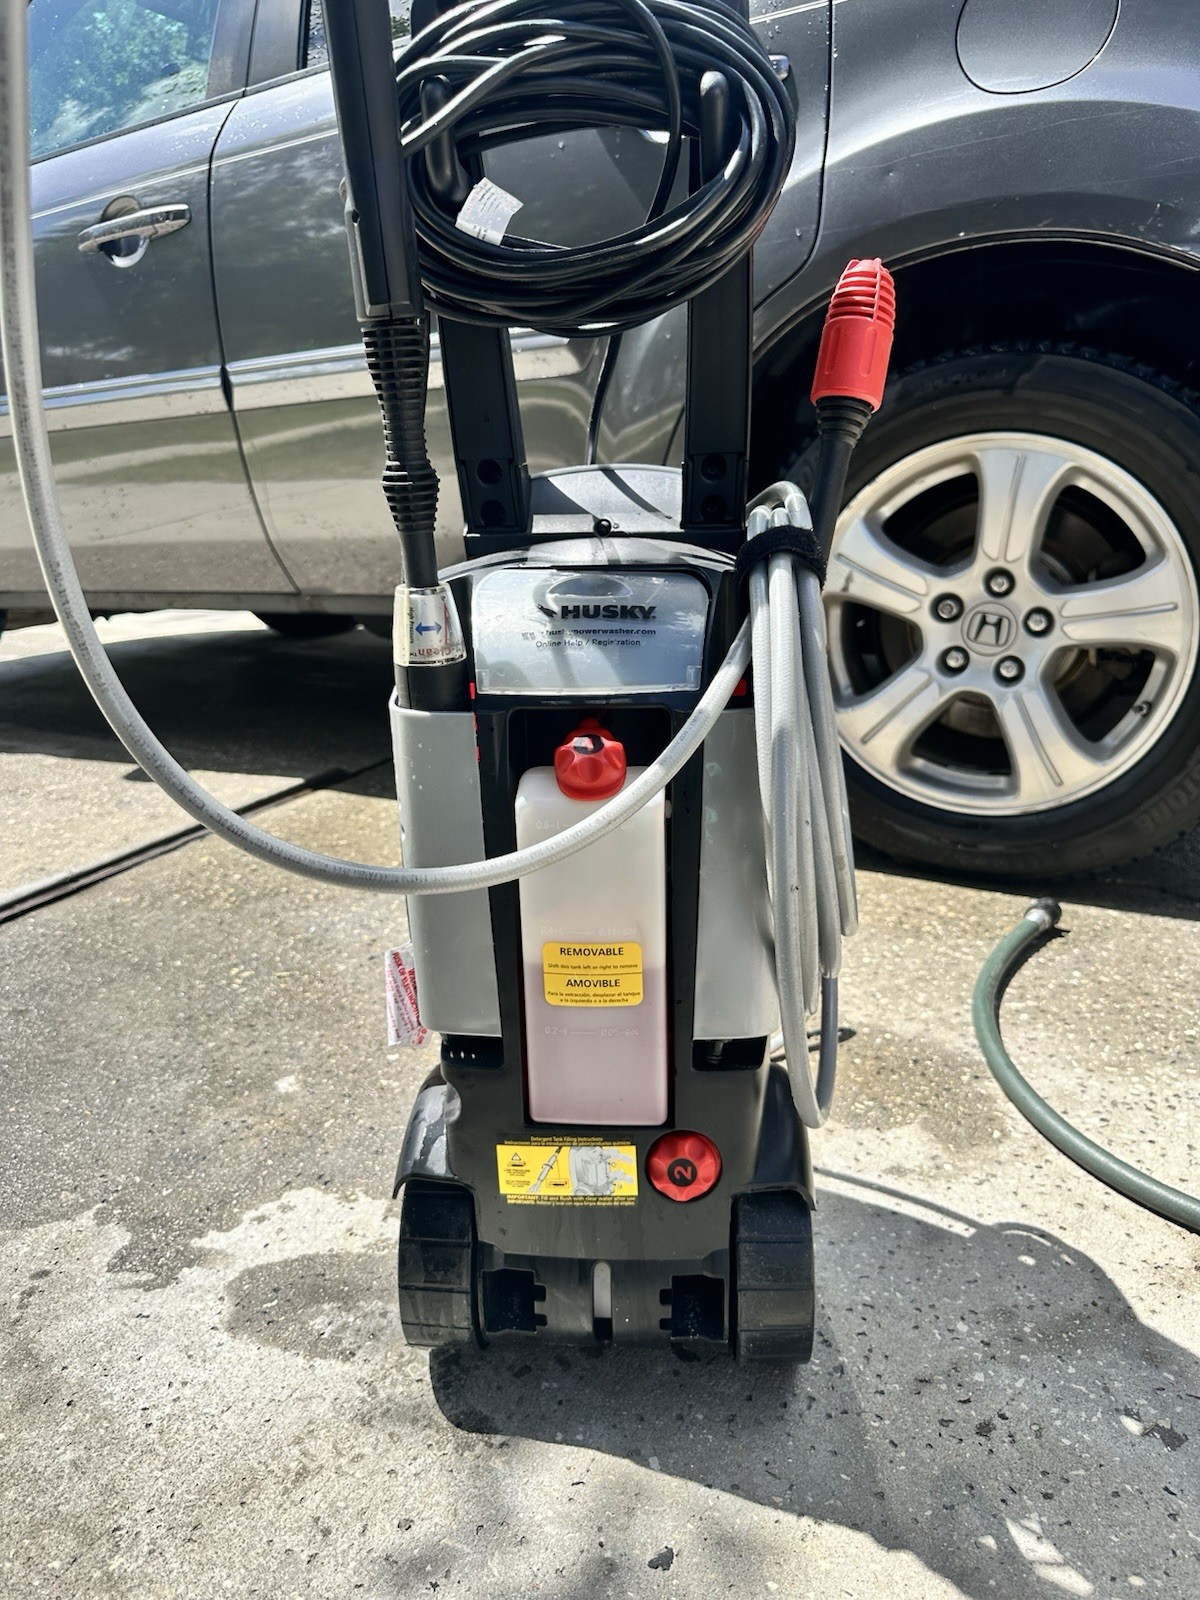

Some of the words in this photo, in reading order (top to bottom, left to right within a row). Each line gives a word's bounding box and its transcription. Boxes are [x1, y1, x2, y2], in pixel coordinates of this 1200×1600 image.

[560, 604, 656, 619] HUSKY
[560, 947, 624, 956] REMOVABLE
[566, 979, 620, 988] AMOVIBLE
[674, 1165, 692, 1180] 2
